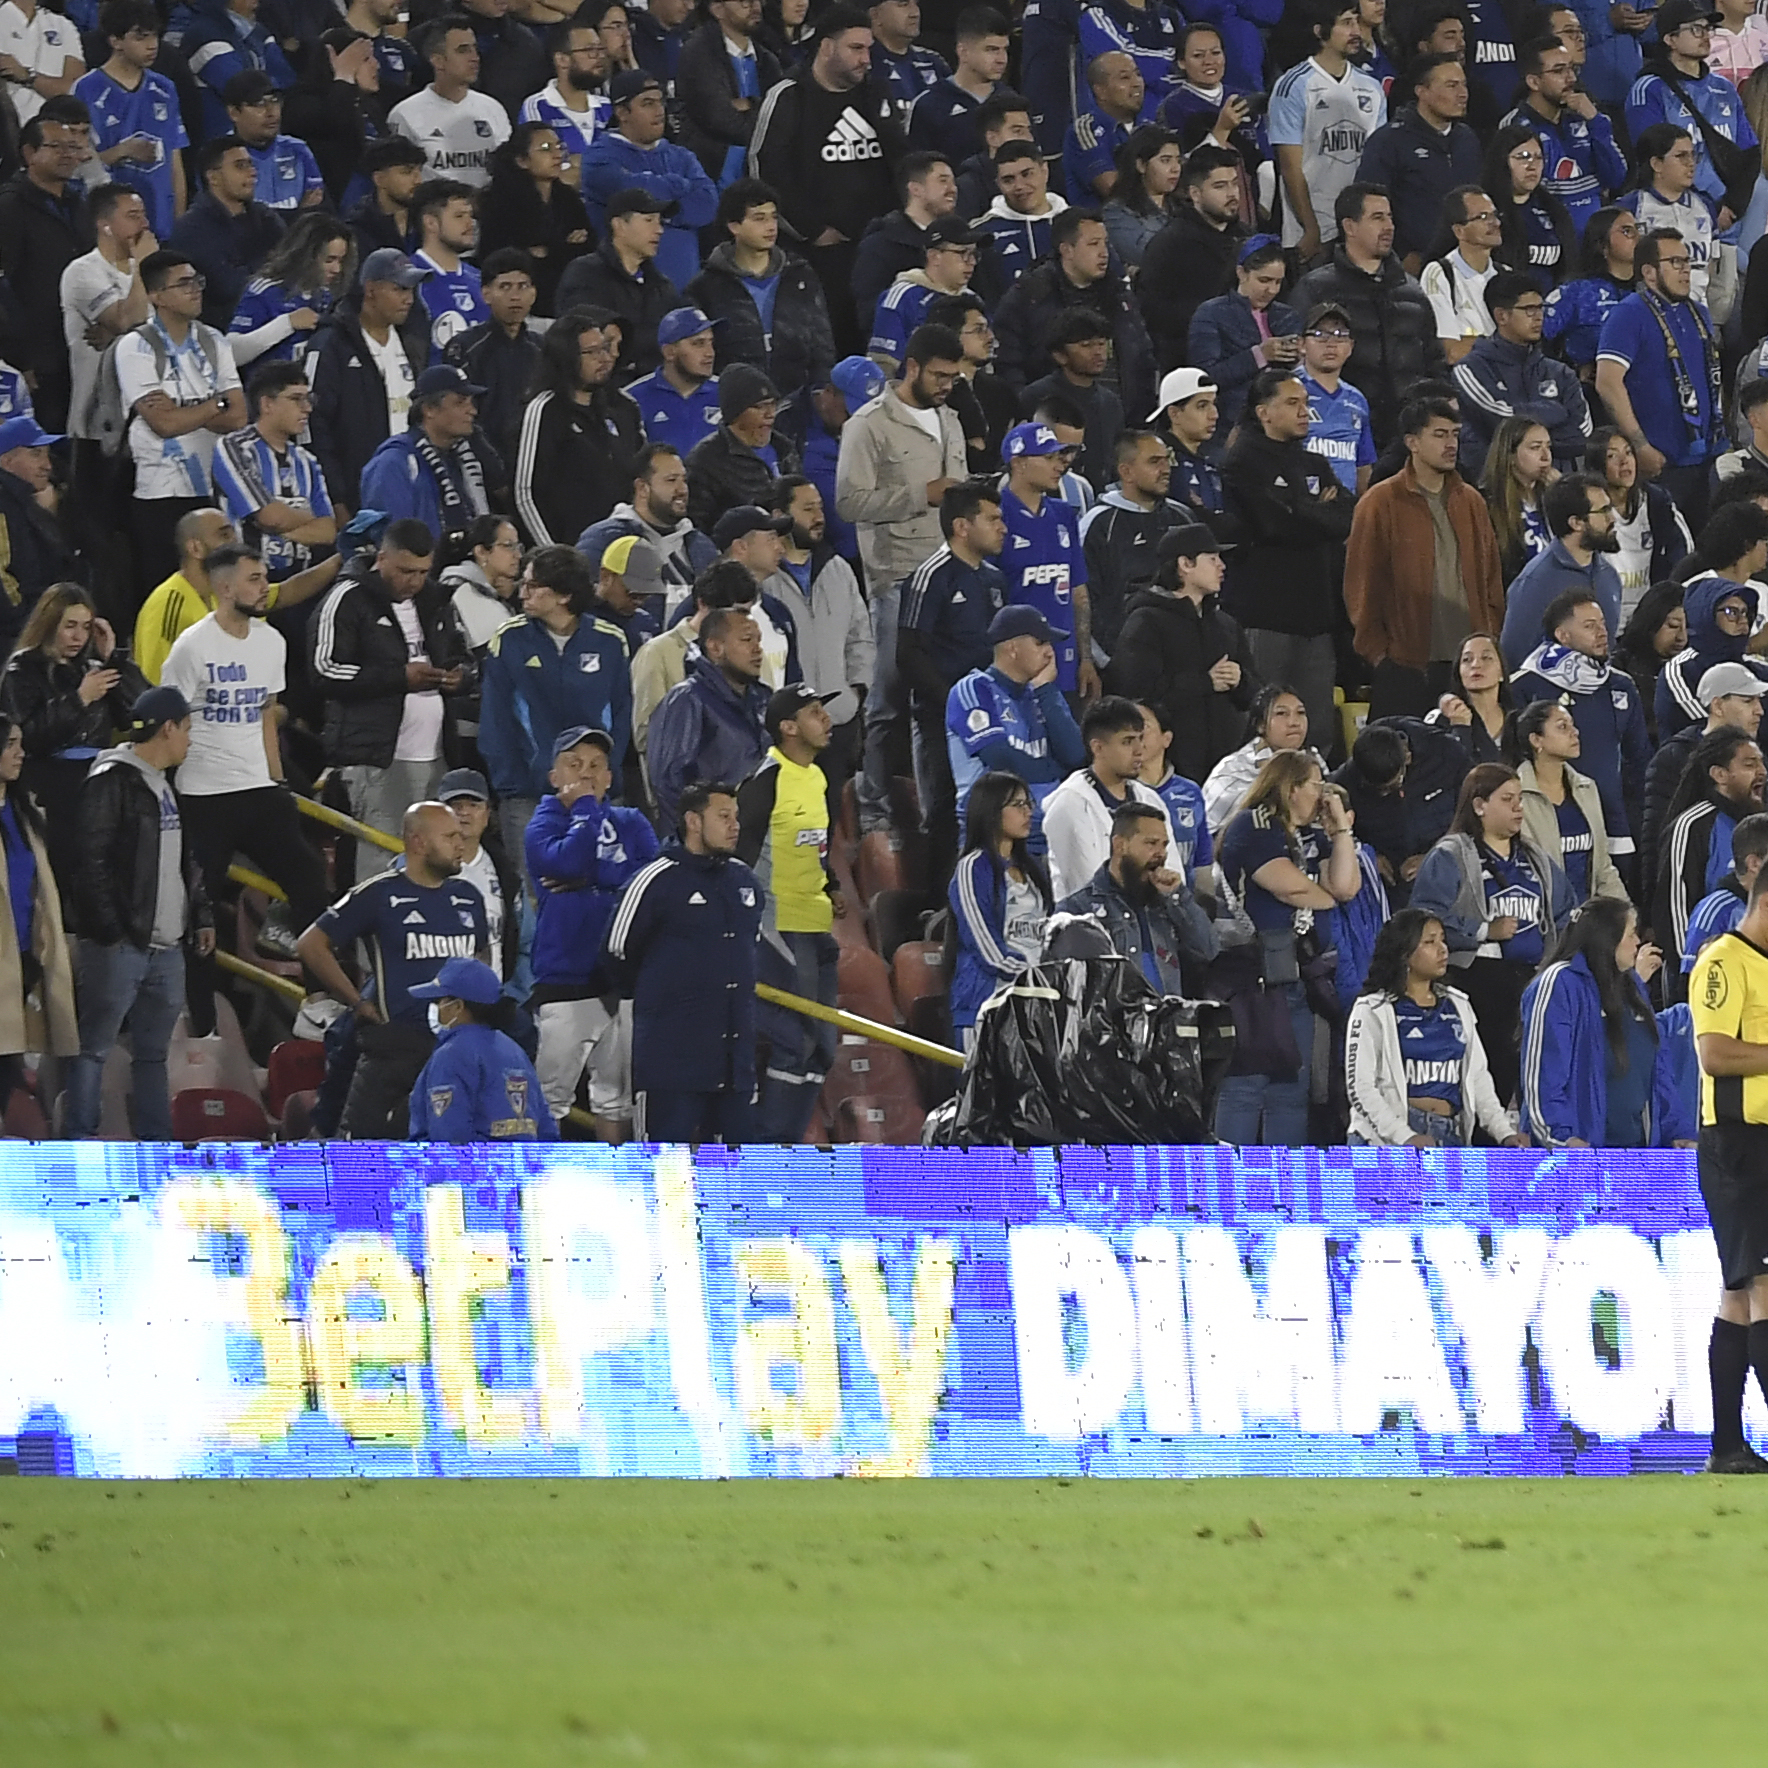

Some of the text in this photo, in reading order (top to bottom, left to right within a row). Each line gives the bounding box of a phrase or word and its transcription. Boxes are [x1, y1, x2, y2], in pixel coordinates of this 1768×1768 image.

[1475, 42, 1516, 63] ANDI
[821, 140, 883, 162] adidas
[1307, 437, 1357, 462] ANDINA
[406, 933, 476, 960] ANDINA
[1703, 959, 1724, 1011] Kalley
[1406, 1059, 1462, 1085] ANDIN
